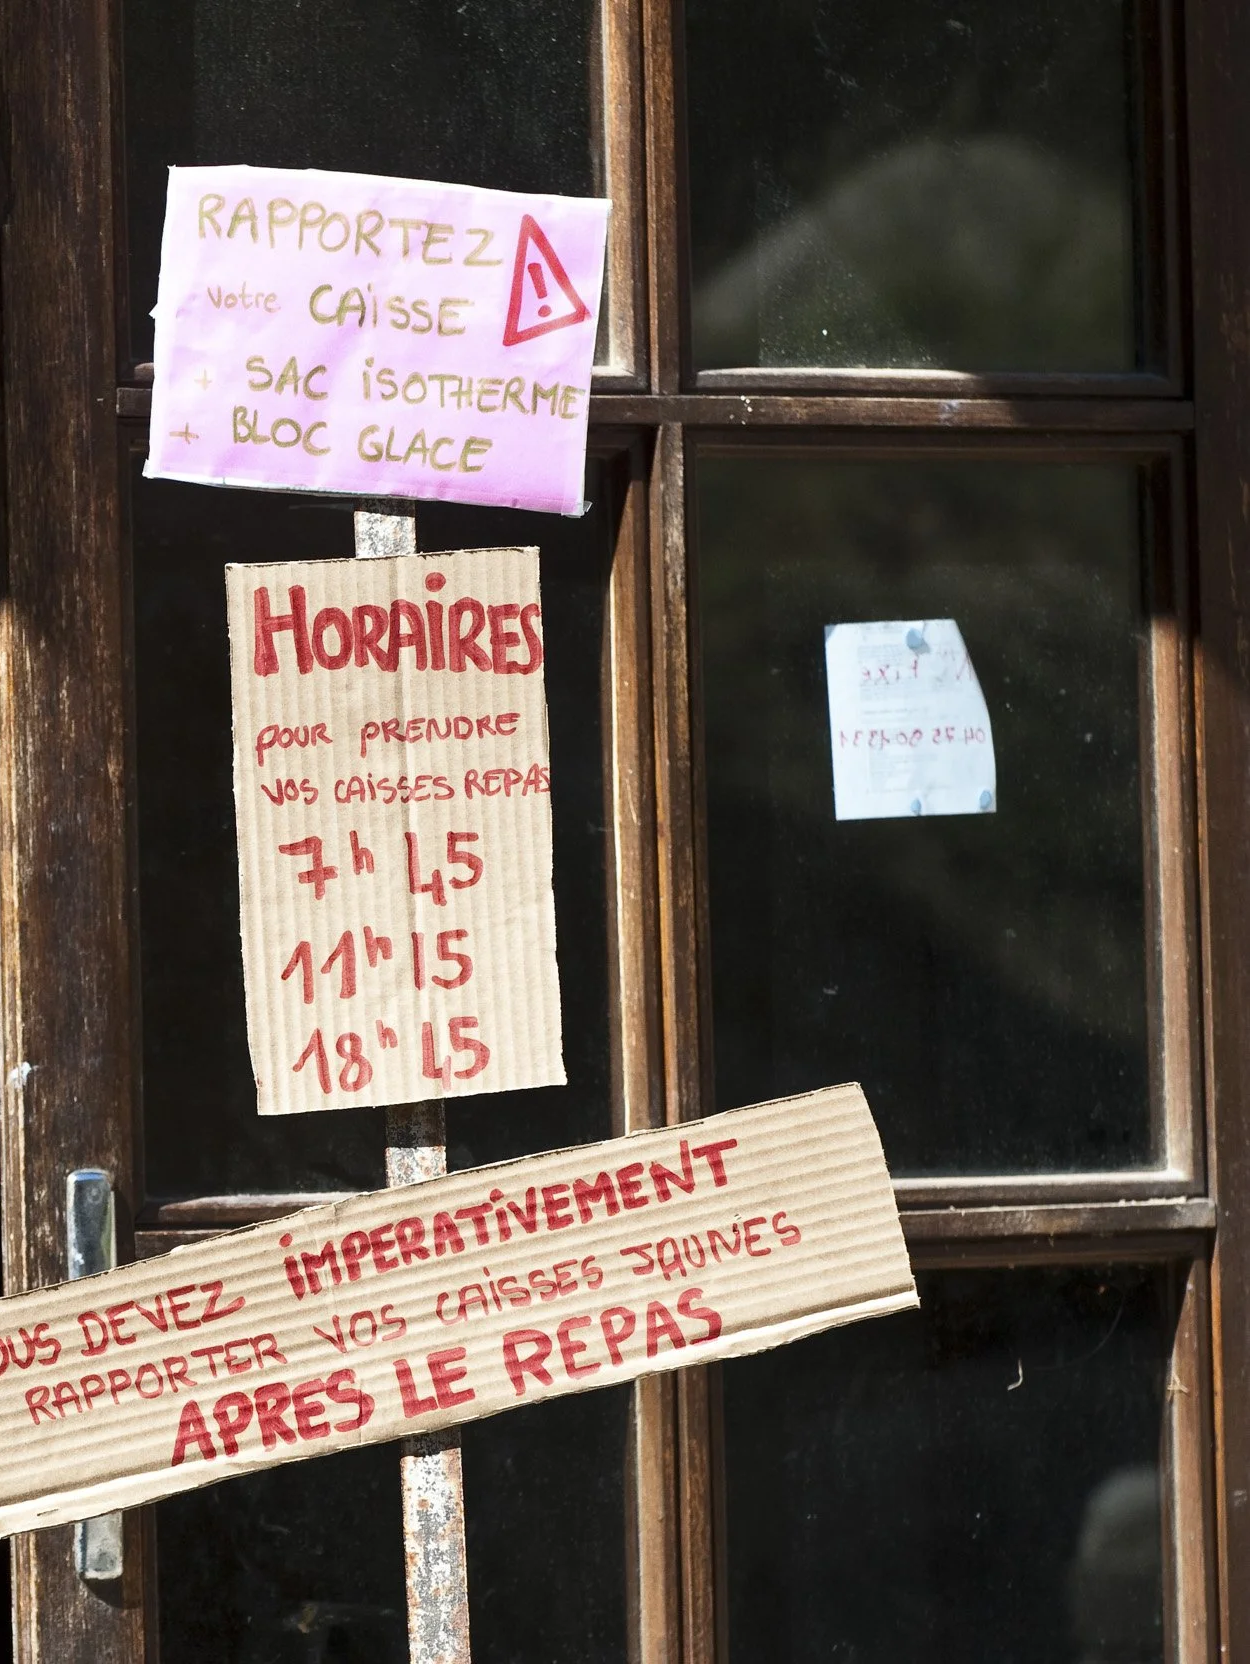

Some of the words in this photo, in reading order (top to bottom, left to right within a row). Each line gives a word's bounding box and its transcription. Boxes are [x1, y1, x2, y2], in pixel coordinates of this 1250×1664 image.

[199, 195, 500, 266] RAPPORTEZ
[246, 357, 327, 400] SAC
[233, 406, 329, 455] BLOC
[358, 425, 492, 472] GLACE
[261, 778, 318, 806] VOS
[25, 1332, 287, 1425] RAPPORTER
[313, 1304, 407, 1353] VOS
[620, 1211, 801, 1281] JAUNES
[77, 1277, 245, 1356] DEVEZ
[171, 1368, 376, 1468] APRES
[393, 1346, 476, 1419] LE
[503, 1287, 723, 1397] REPAS
